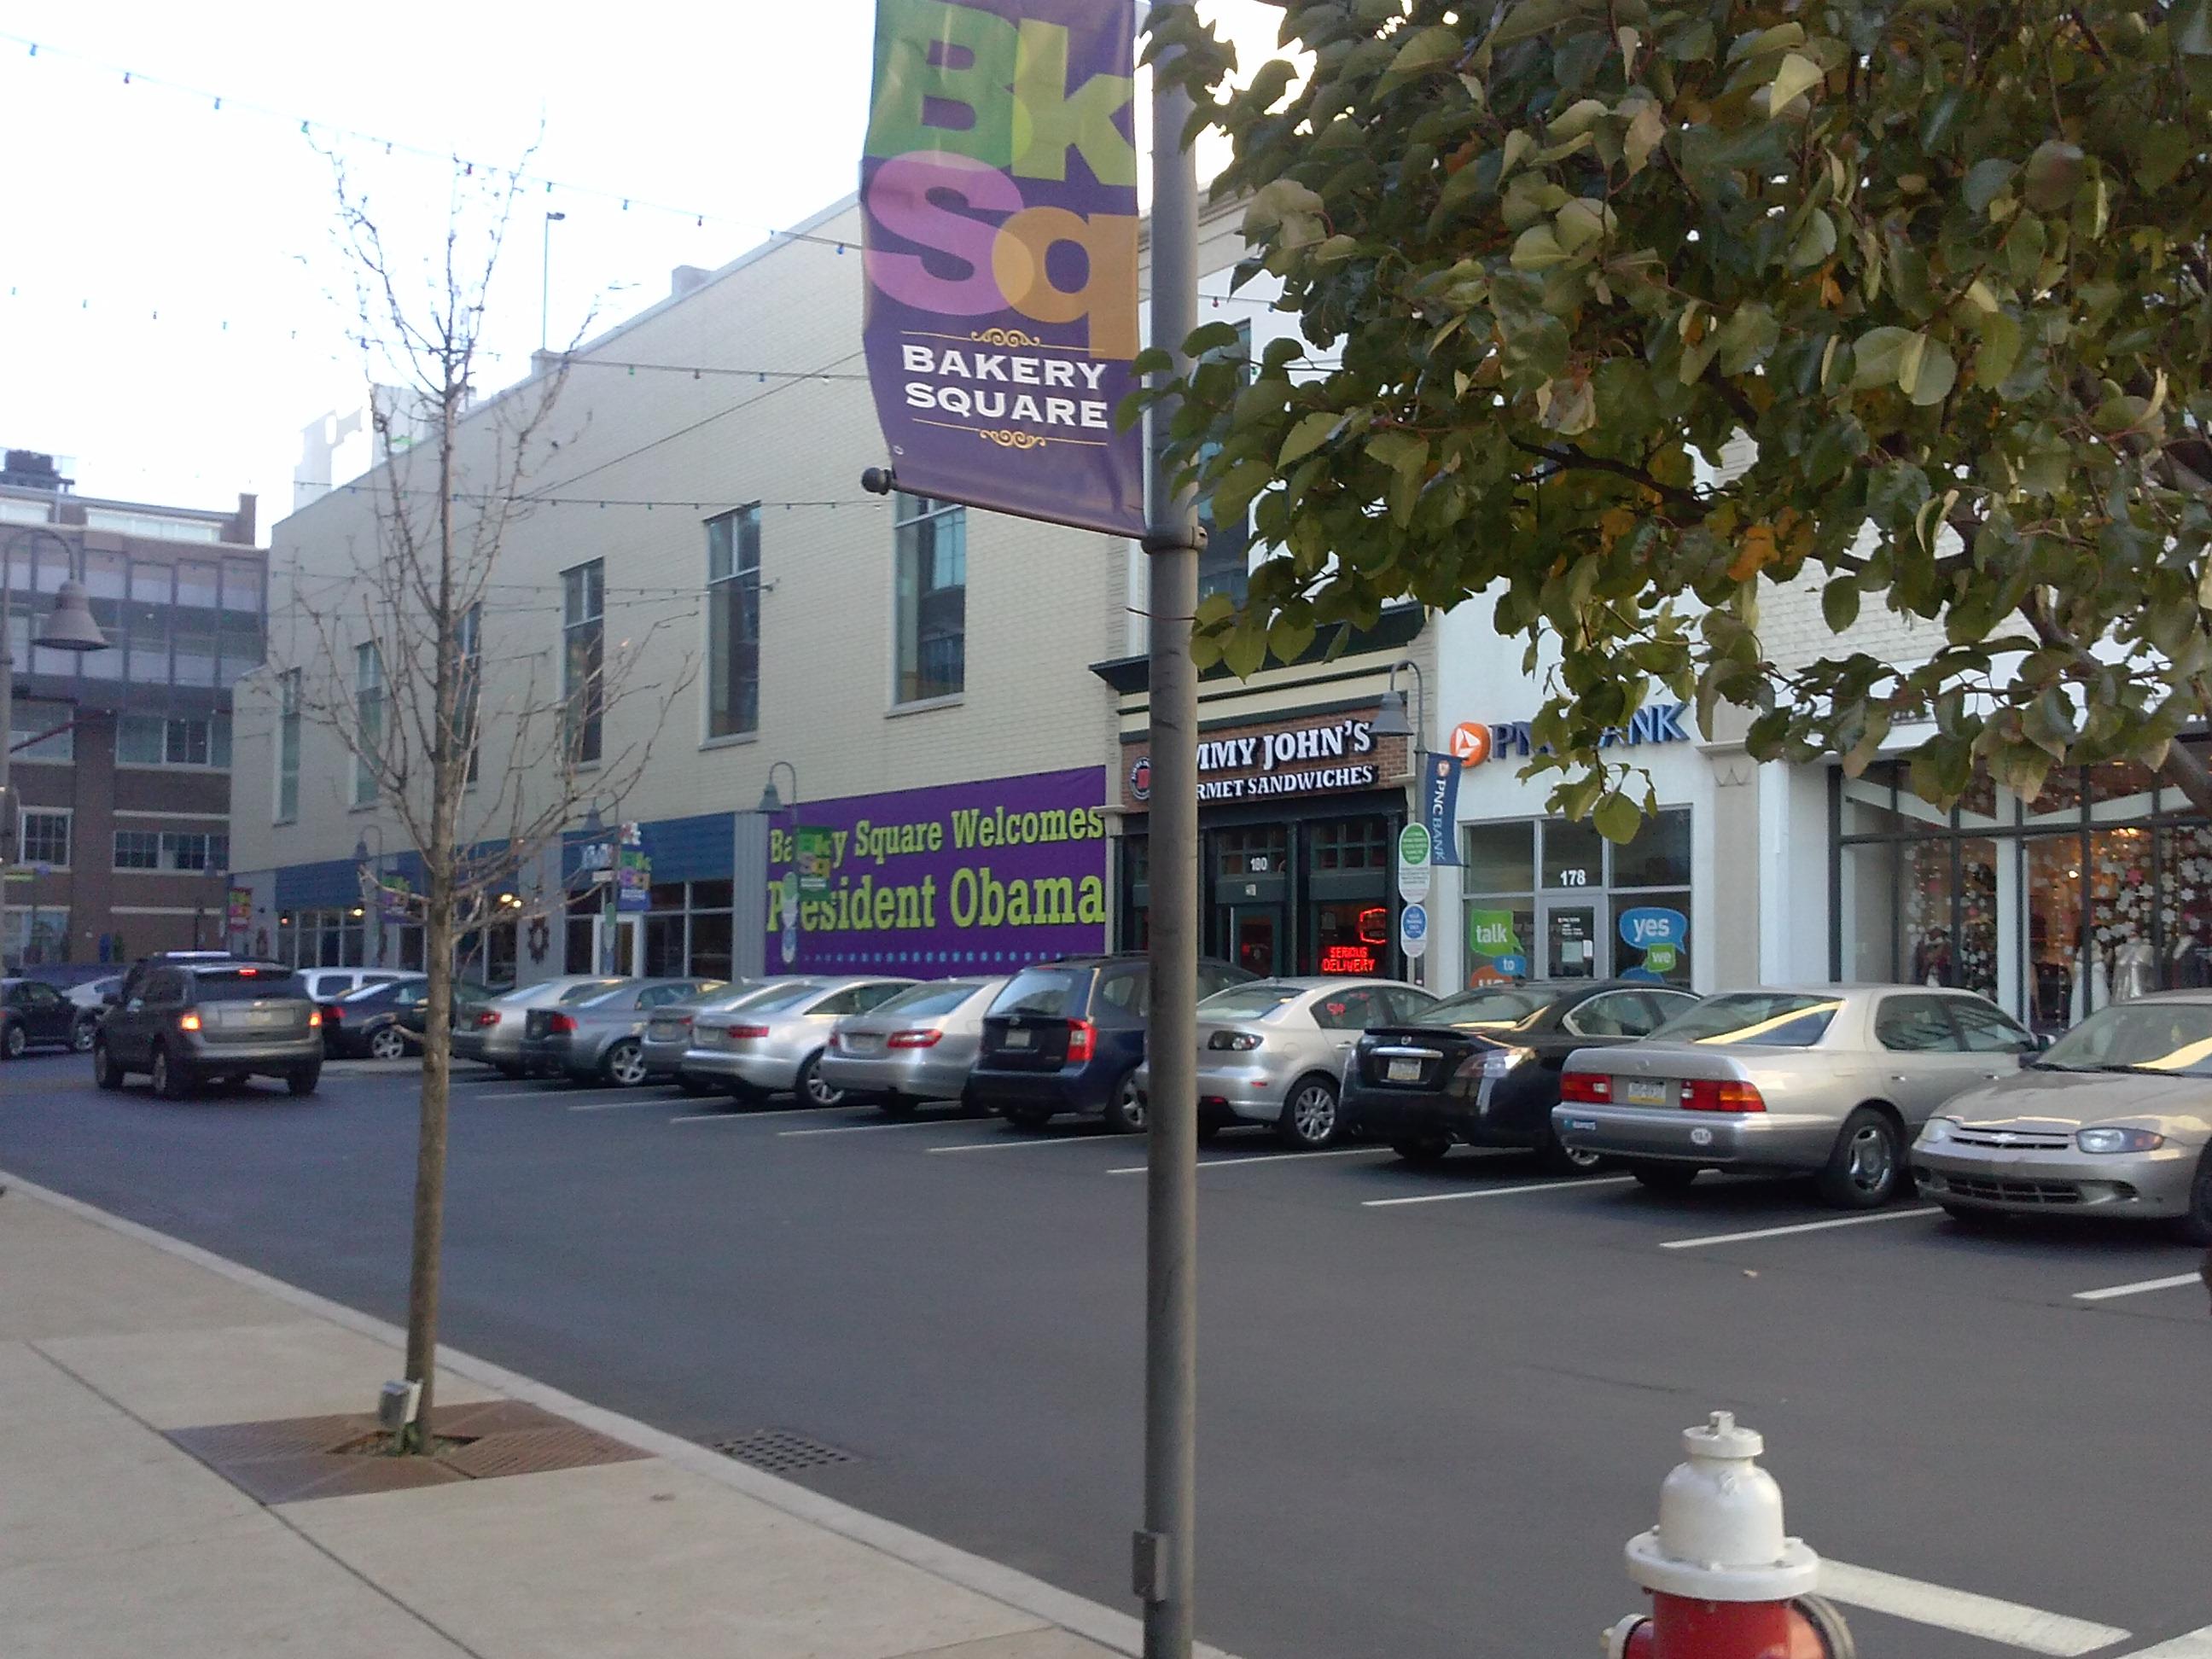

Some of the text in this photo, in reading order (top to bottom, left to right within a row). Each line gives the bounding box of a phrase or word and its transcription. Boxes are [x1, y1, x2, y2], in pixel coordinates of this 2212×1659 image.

[864, 0, 1137, 187] Bk
[864, 151, 1140, 361] Sq
[901, 345, 1108, 390] BAKERY
[905, 382, 1109, 429] SQUARE
[1263, 720, 1371, 770] JOHN'S
[1196, 765, 1373, 800] RMET SANDWICHES
[854, 819, 943, 865] Square
[951, 805, 1106, 850] Welcomes
[1431, 779, 1447, 862] PNC BANK
[1560, 870, 1586, 887] 178
[766, 867, 1107, 932] Pesident Obama
[1476, 924, 1508, 943] talk
[1633, 917, 1669, 942] yes
[1322, 959, 1377, 973] DELIVERY
[1330, 946, 1368, 958] SERIOUS
[1503, 957, 1516, 971] to
[1652, 952, 1674, 964] we
